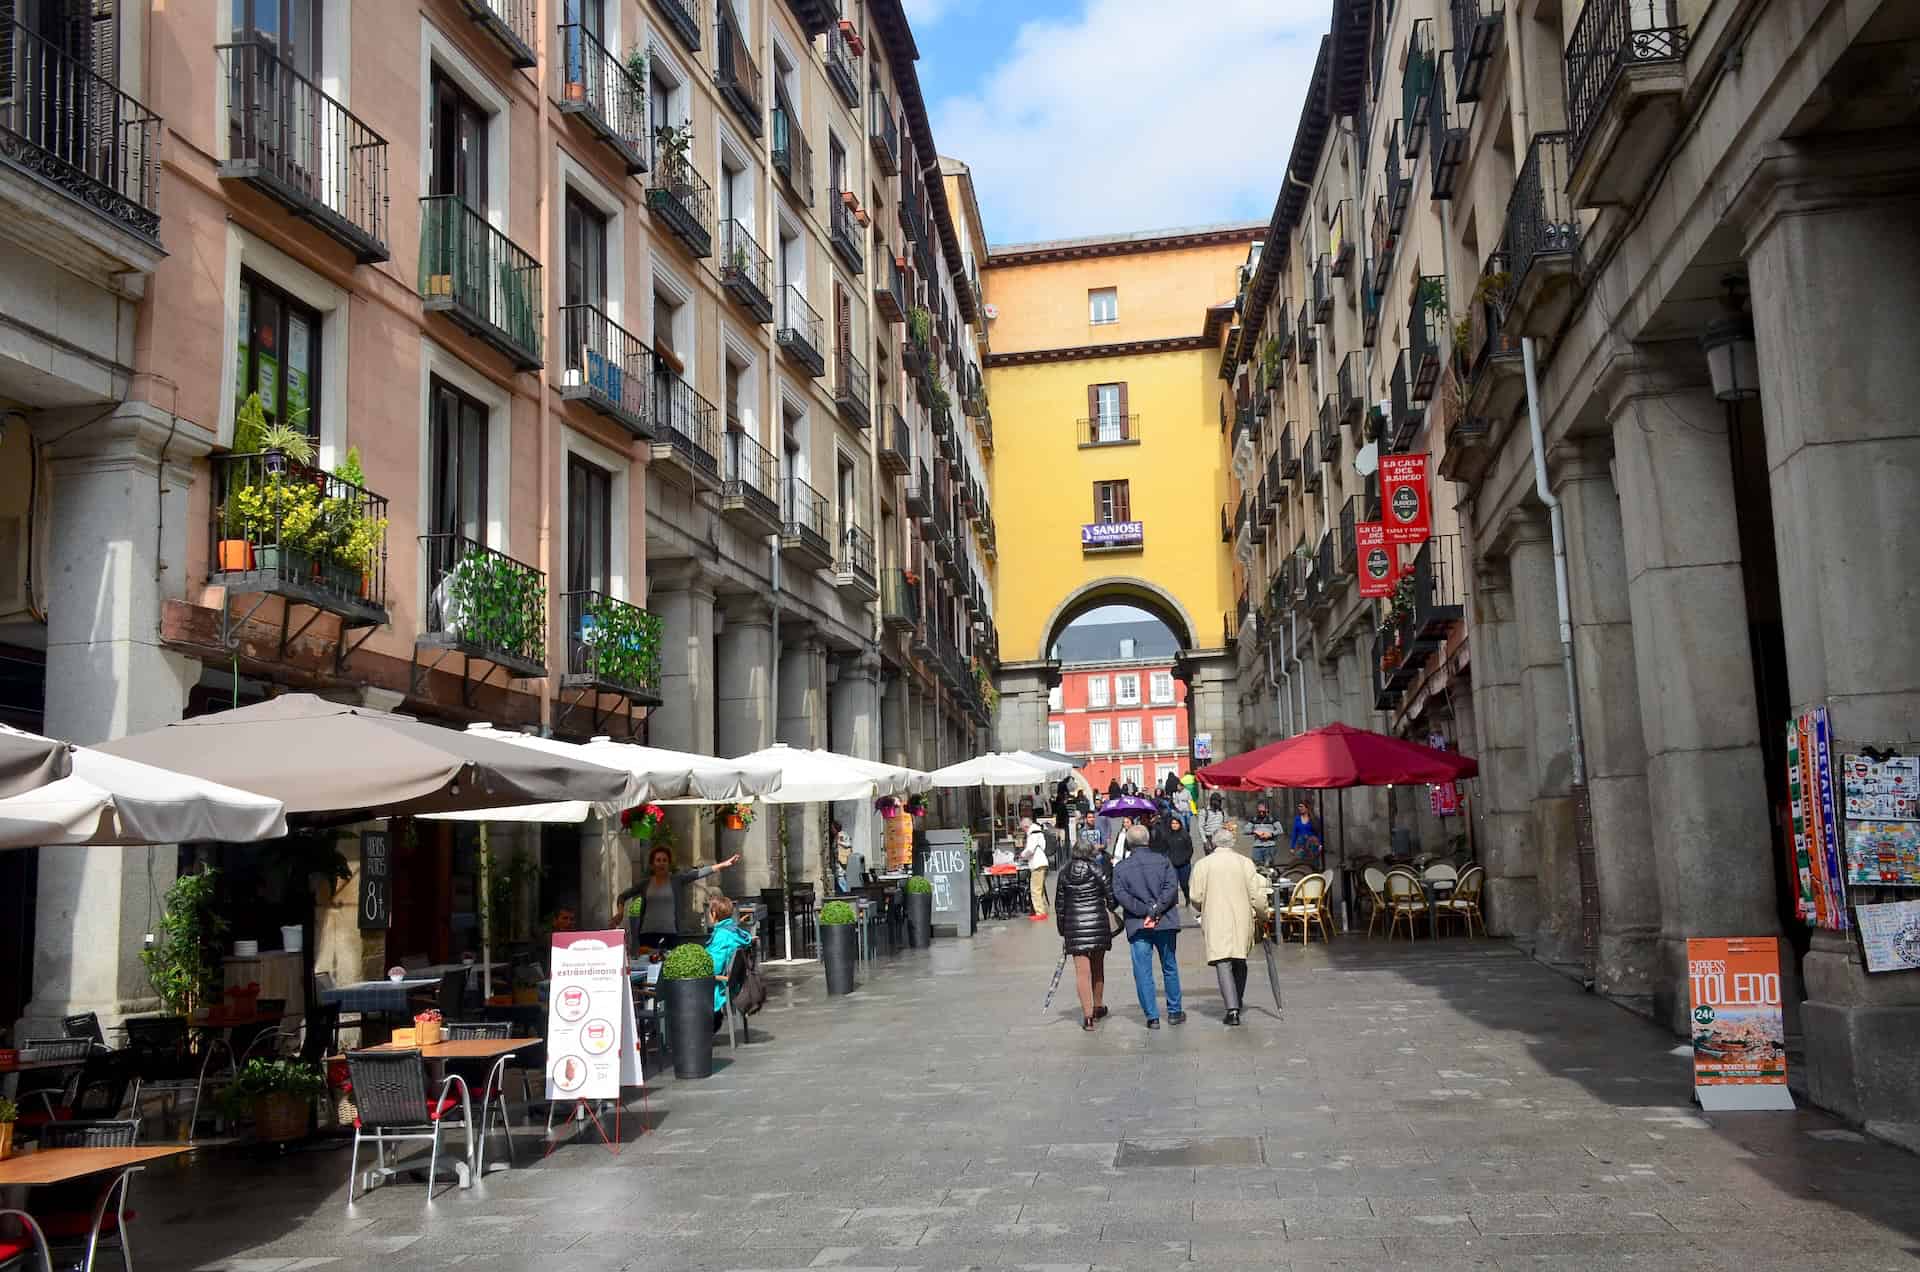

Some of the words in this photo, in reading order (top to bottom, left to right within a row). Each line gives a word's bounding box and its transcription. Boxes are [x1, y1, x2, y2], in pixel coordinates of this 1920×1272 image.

[1397, 459, 1424, 467] CASA
[1688, 960, 1726, 975] EXPRESS
[1689, 973, 1781, 1005] TOLEDO
